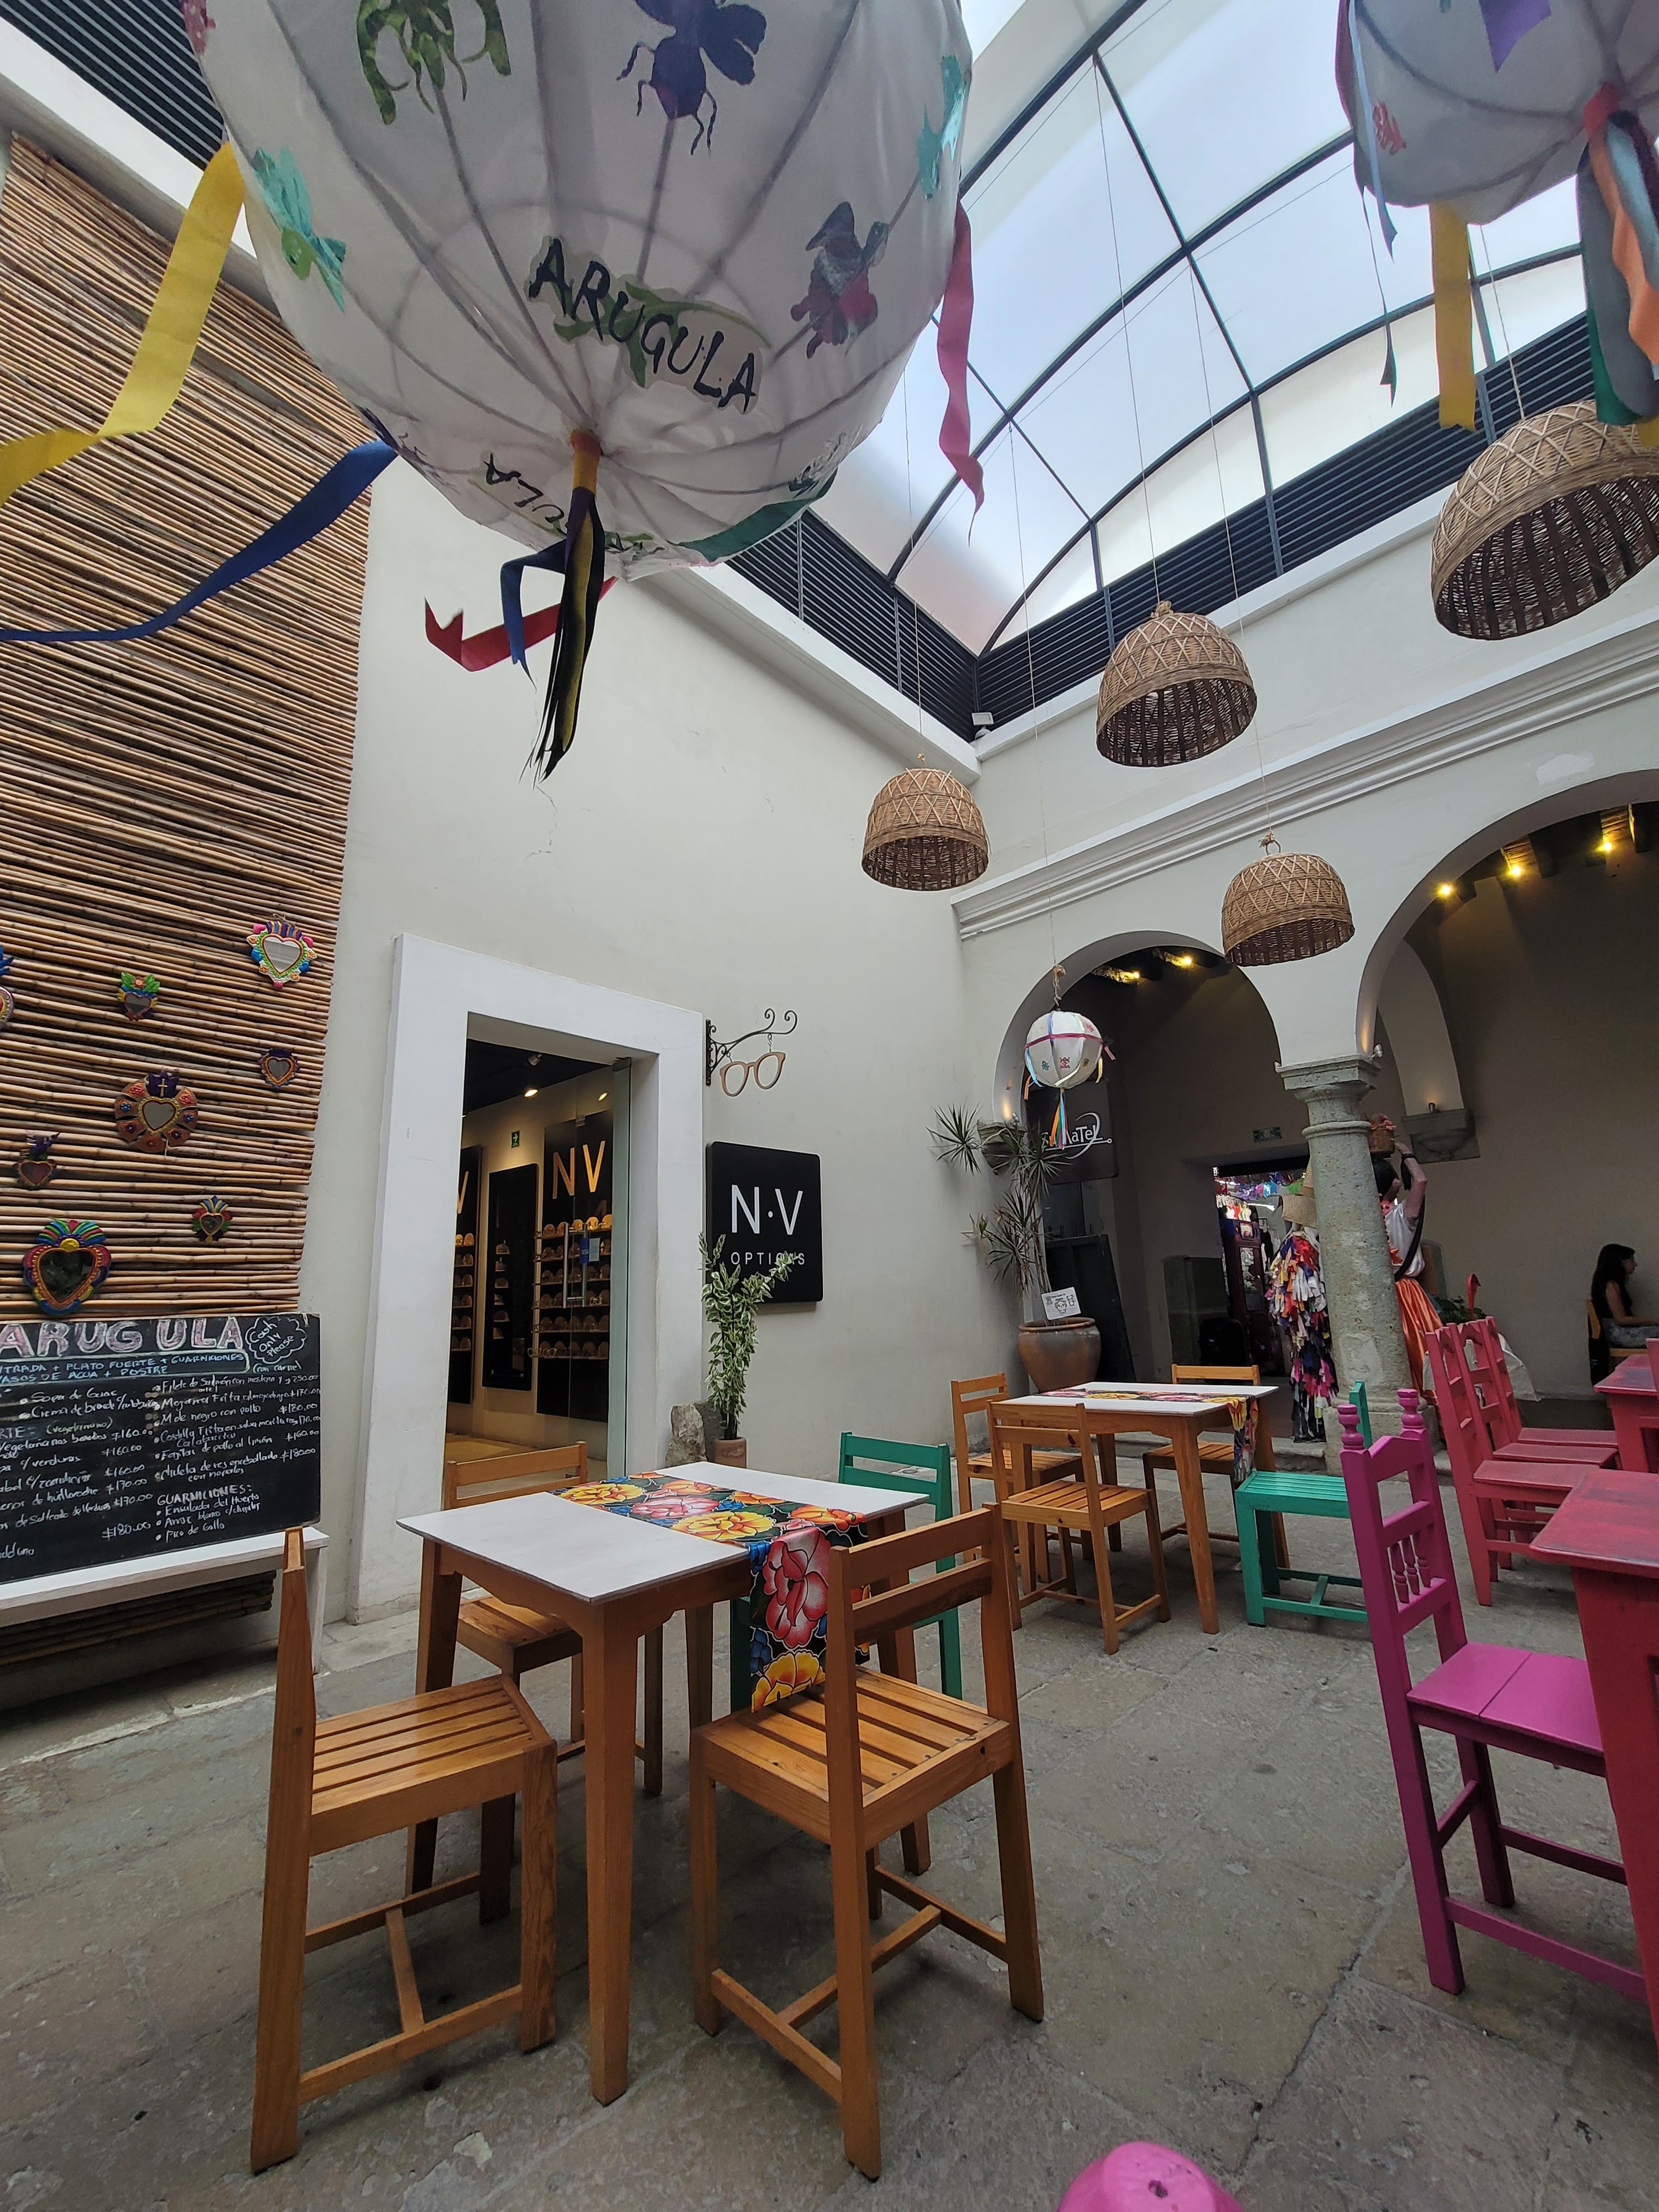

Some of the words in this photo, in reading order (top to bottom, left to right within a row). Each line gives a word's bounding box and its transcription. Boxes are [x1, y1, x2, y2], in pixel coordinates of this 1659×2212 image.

[529, 238, 757, 414] ARUGULA
[250, 1319, 278, 1343] Cash
[259, 1333, 281, 1352] Only
[266, 1335, 295, 1357] Please
[66, 1362, 105, 1371] PLATO
[108, 1358, 157, 1369] FUERTE
[41, 1371, 61, 1381] DE
[120, 1365, 169, 1376] POSTRE
[31, 1391, 65, 1403] Sopa
[31, 1405, 68, 1418] Crema
[190, 1411, 218, 1423] negro
[239, 1403, 262, 1415] pollo
[213, 1439, 234, 1453] pollo
[188, 1473, 206, 1482] con
